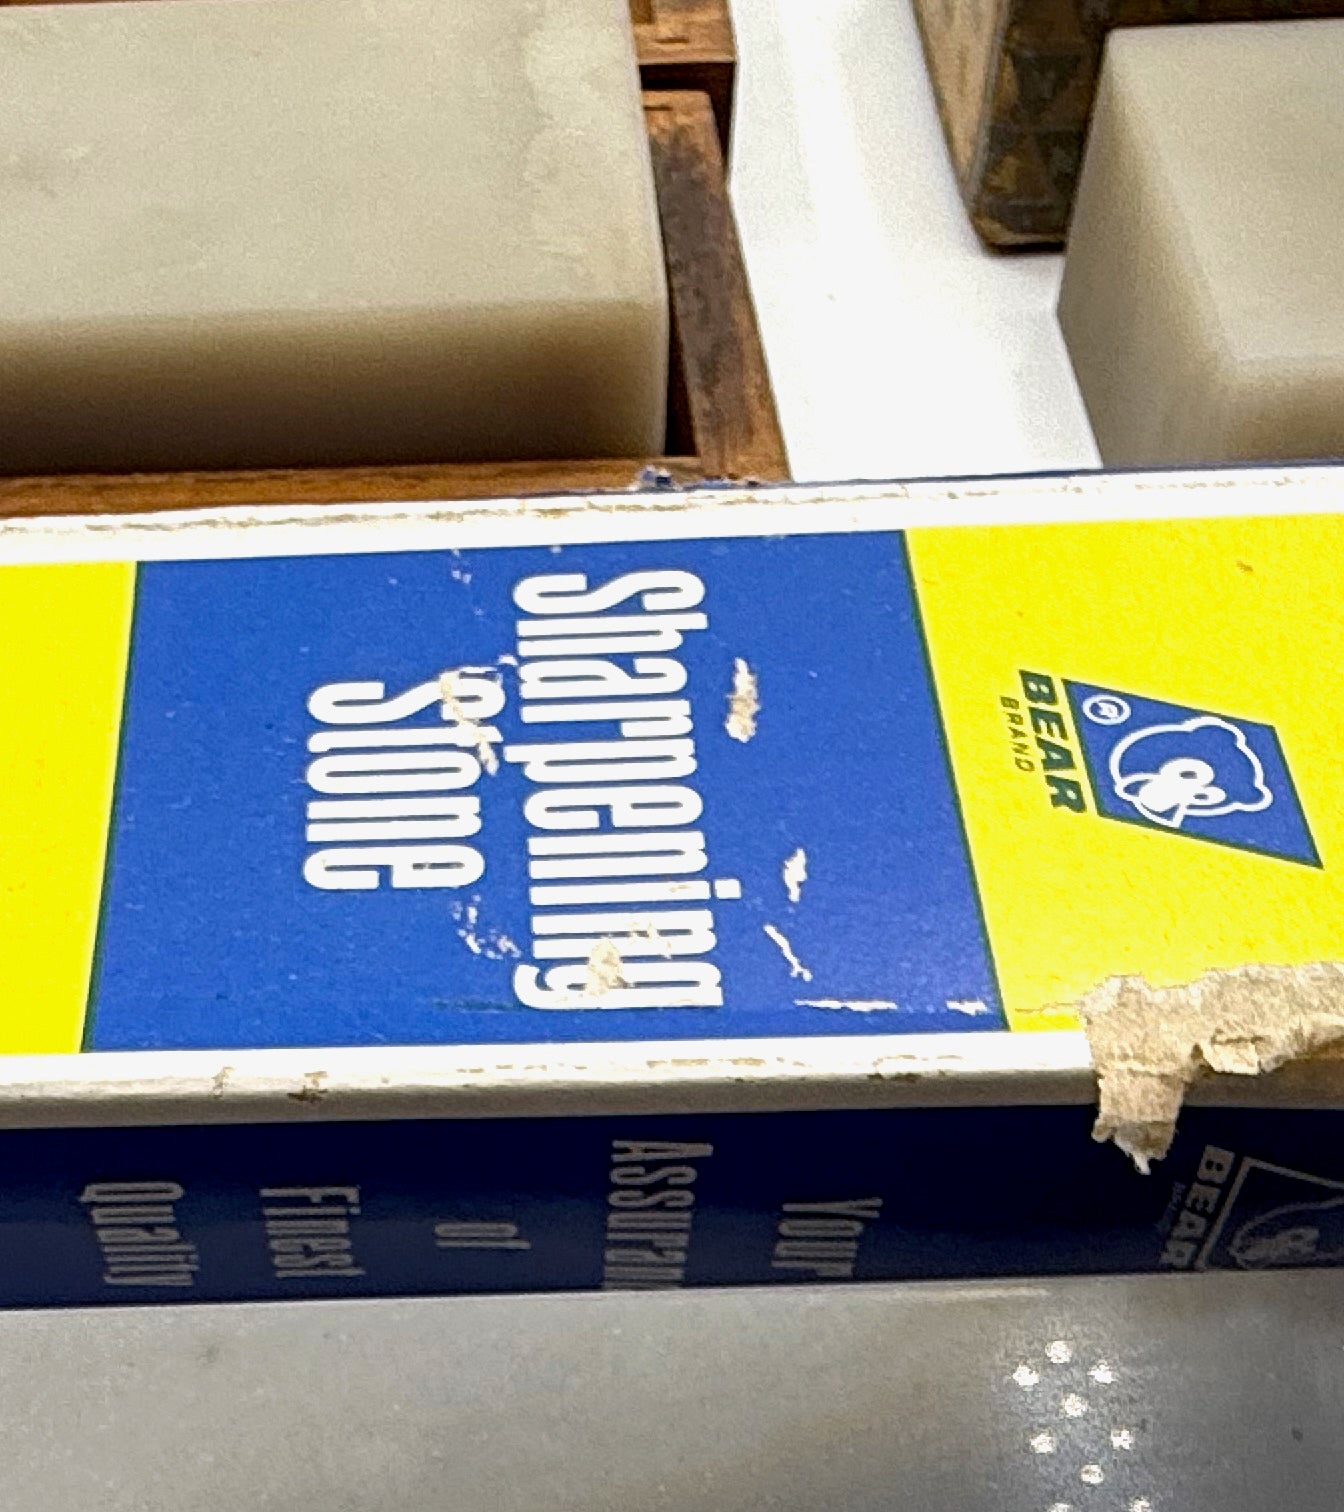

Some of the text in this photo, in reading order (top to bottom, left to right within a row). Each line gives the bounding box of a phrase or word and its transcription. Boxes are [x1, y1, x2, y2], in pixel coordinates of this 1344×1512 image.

[302, 666, 506, 890] Stone
[1000, 695, 1035, 772] BRAND
[1018, 669, 1088, 813] BEAR
[504, 570, 741, 1010] Sharpening
[79, 1182, 200, 1286] Quality
[260, 1186, 366, 1277] Finest
[434, 1222, 531, 1249] of
[771, 1197, 883, 1276] Your
[1159, 1145, 1236, 1267] BEAR
